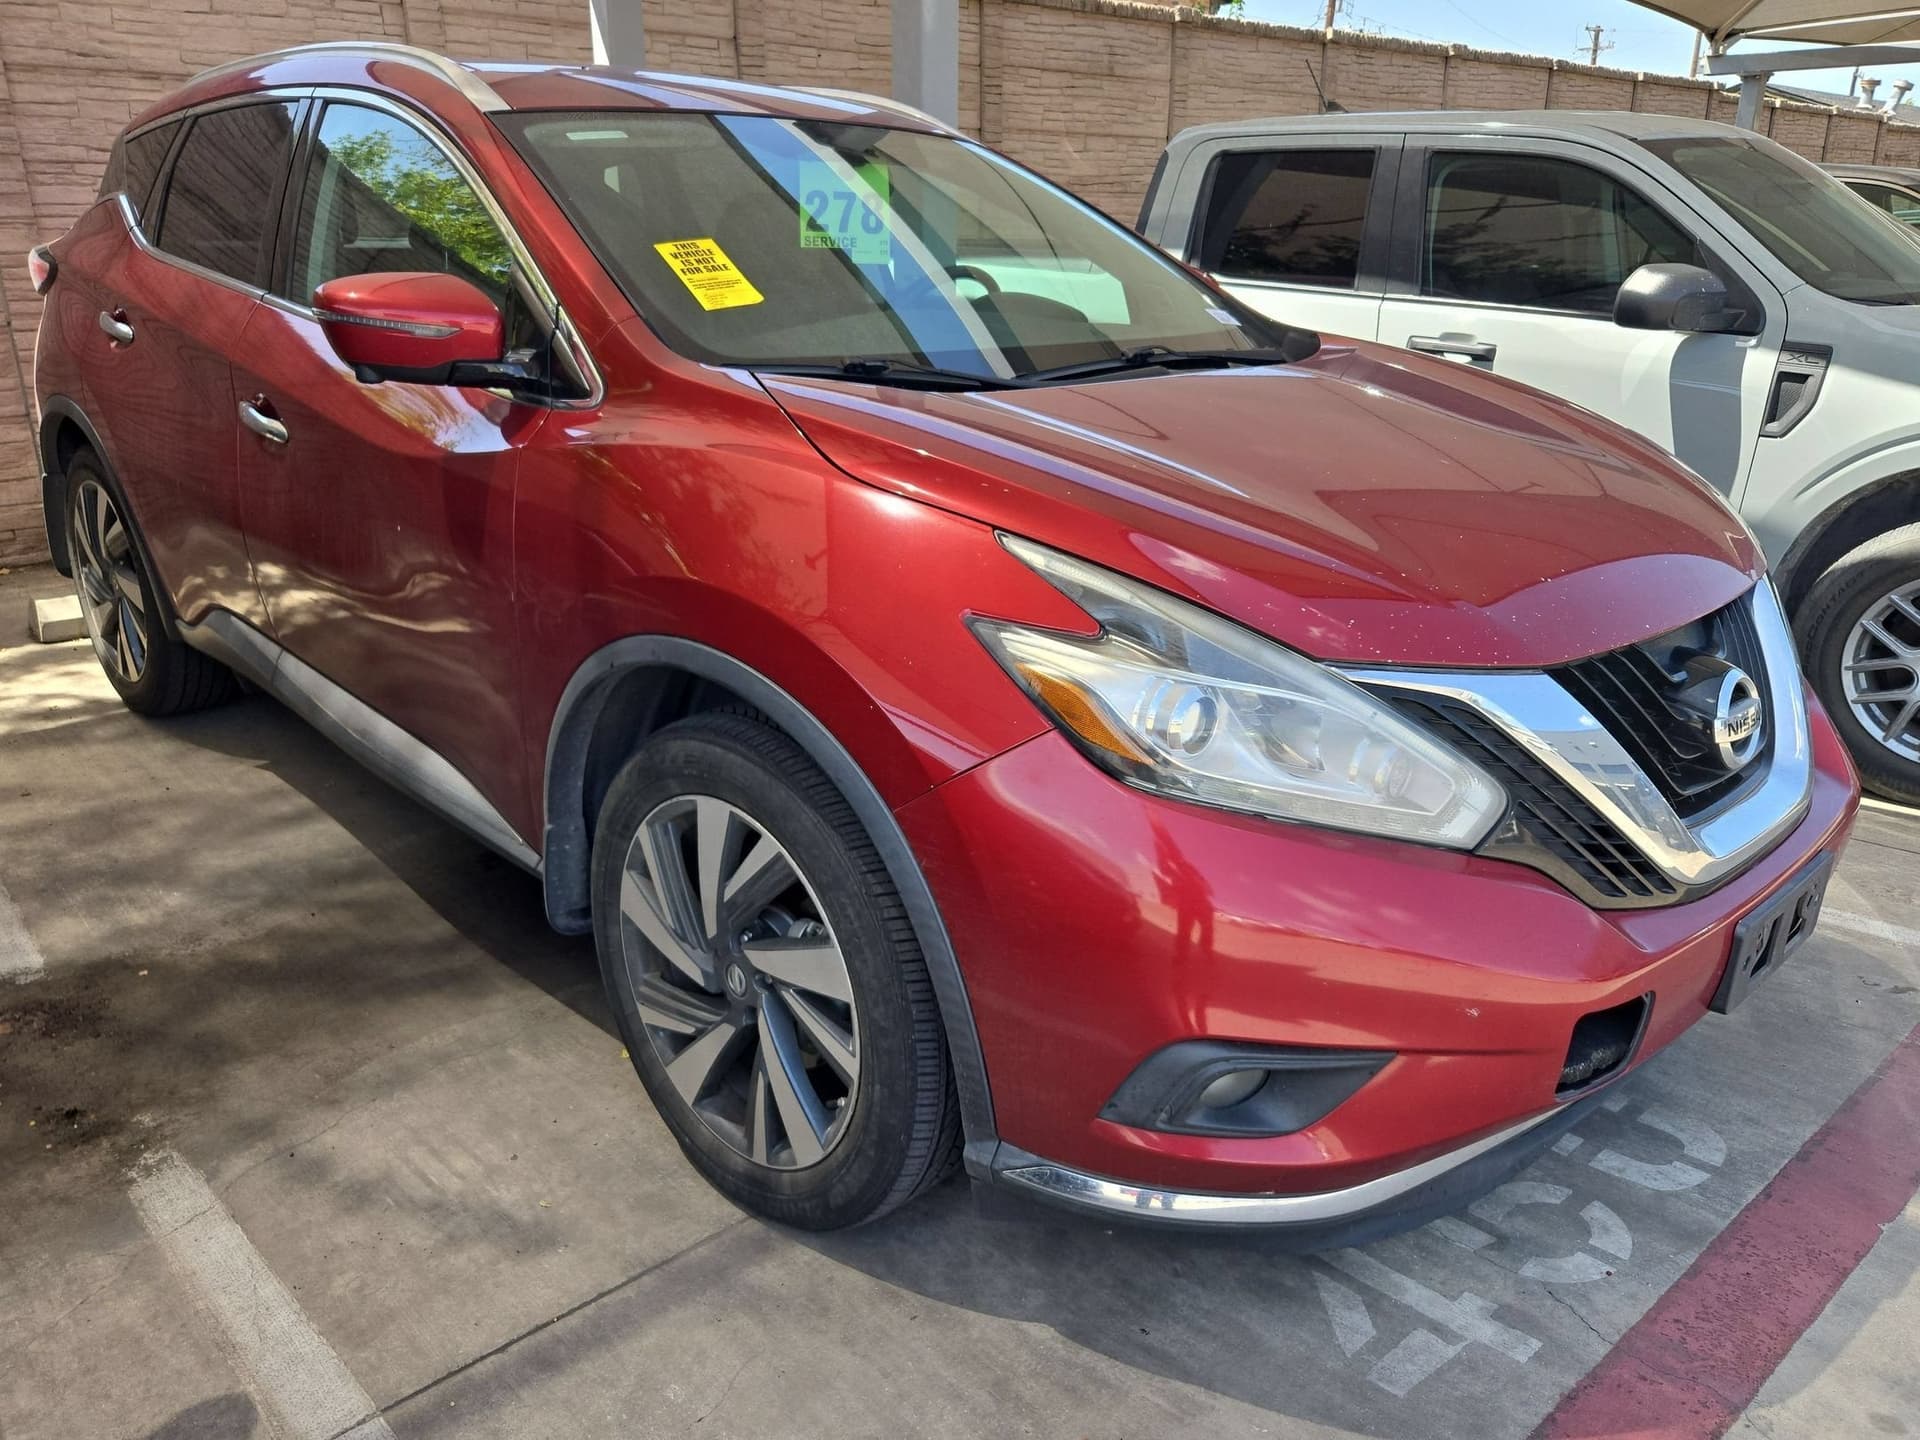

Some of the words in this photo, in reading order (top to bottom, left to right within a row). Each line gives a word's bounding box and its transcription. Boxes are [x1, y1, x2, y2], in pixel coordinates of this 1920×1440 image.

[805, 190, 884, 234] 278
[672, 242, 700, 251] THIS
[804, 235, 857, 248] SERVICE
[669, 248, 716, 260] VEHICLE
[680, 259, 694, 267] IS
[695, 256, 717, 266] NOT
[680, 267, 704, 276] FOR
[703, 263, 731, 273] SALE
[1786, 353, 1819, 365] XL
[1728, 708, 1760, 737] NISSA
